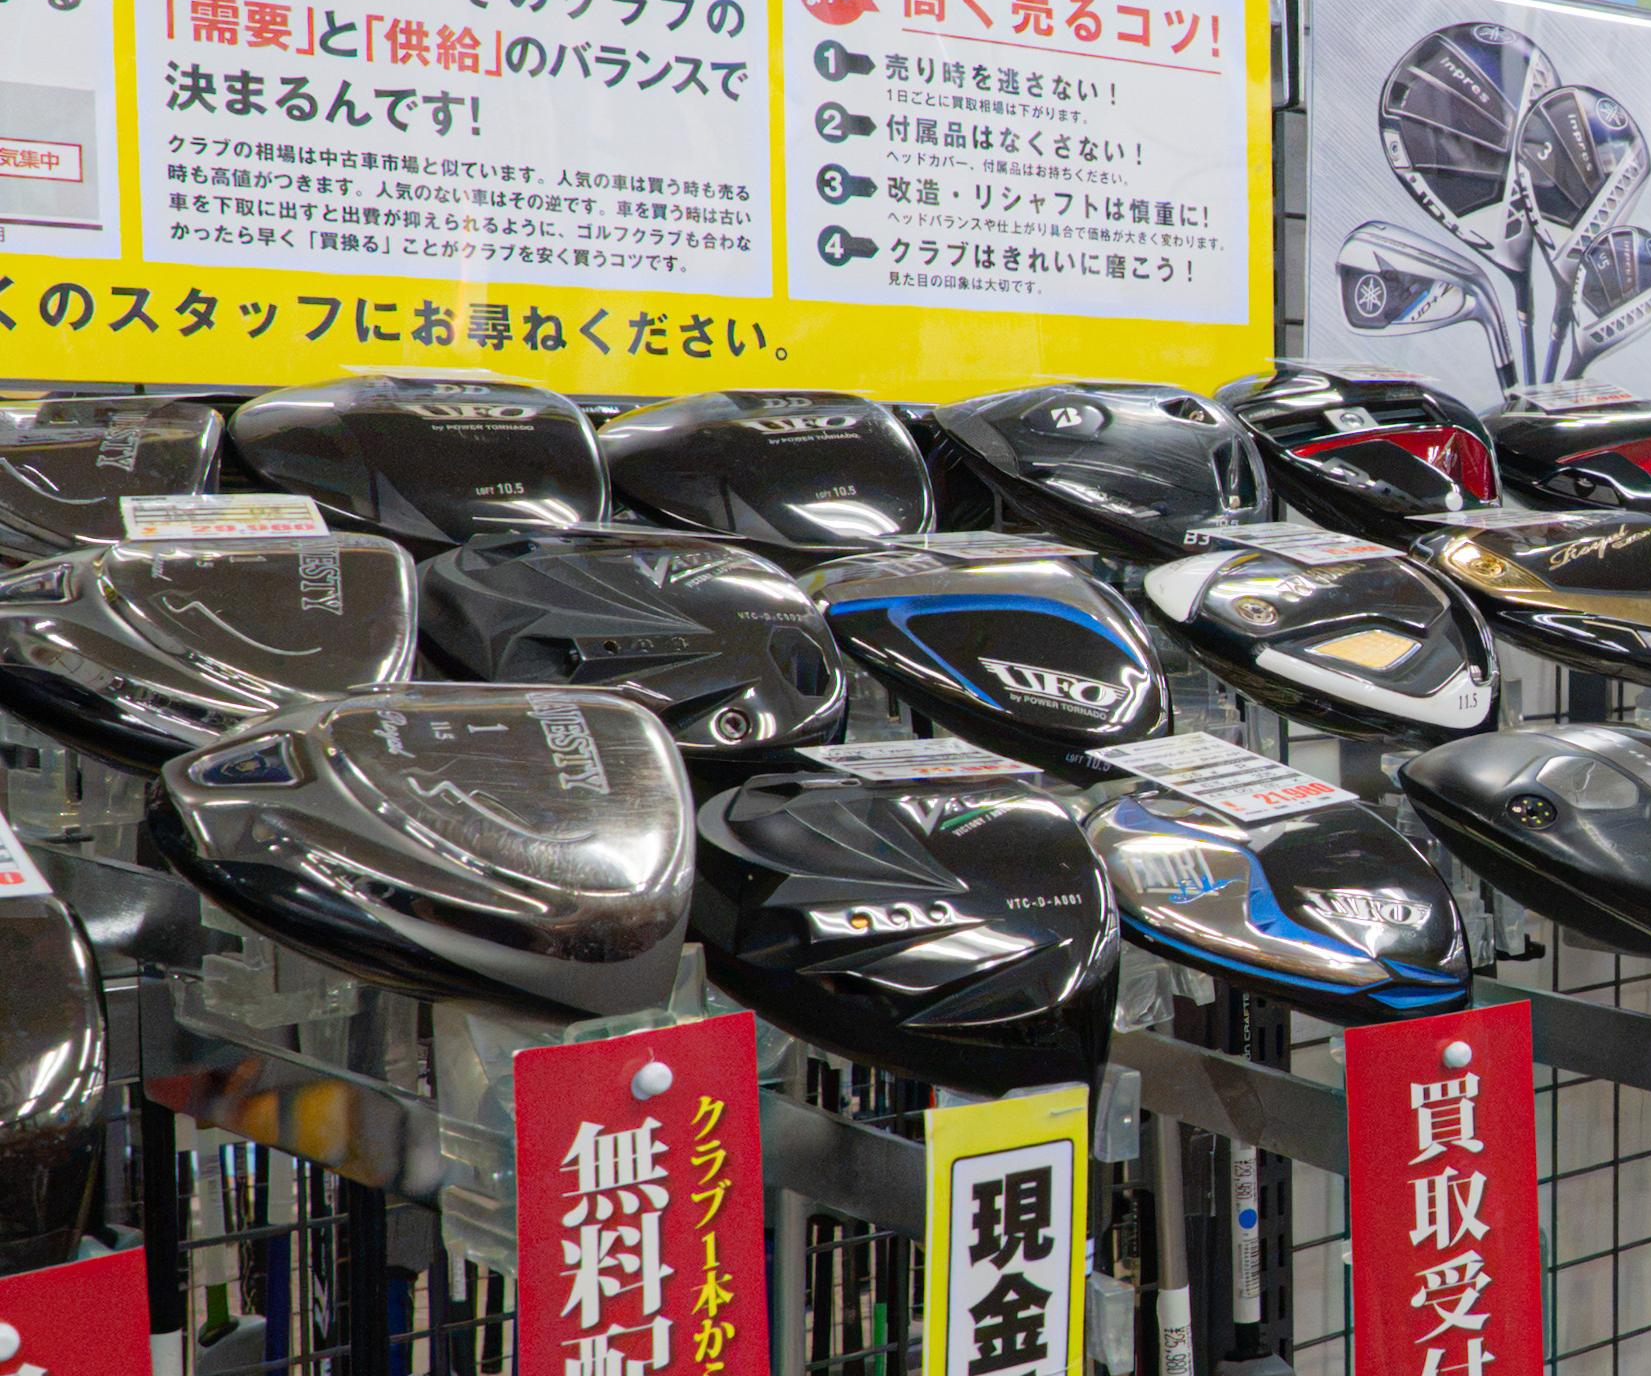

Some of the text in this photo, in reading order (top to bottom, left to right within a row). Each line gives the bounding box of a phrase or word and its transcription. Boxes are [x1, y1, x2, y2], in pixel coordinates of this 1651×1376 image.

[887, 89, 1086, 124] 1日ごとに買取相場は下がります。
[887, 151, 1127, 186] ヘッドカバー、付属品はお持ちください。
[888, 272, 1043, 296] 見た目の印象は大切です。
[433, 384, 490, 395] DD
[418, 406, 537, 424] UFO
[497, 483, 524, 495] 10.5
[833, 485, 857, 497] 10.5
[990, 663, 1117, 706] UFO
[1024, 694, 1057, 711] POWER
[1060, 701, 1107, 720] TORNADO
[1458, 693, 1478, 710] 11.5
